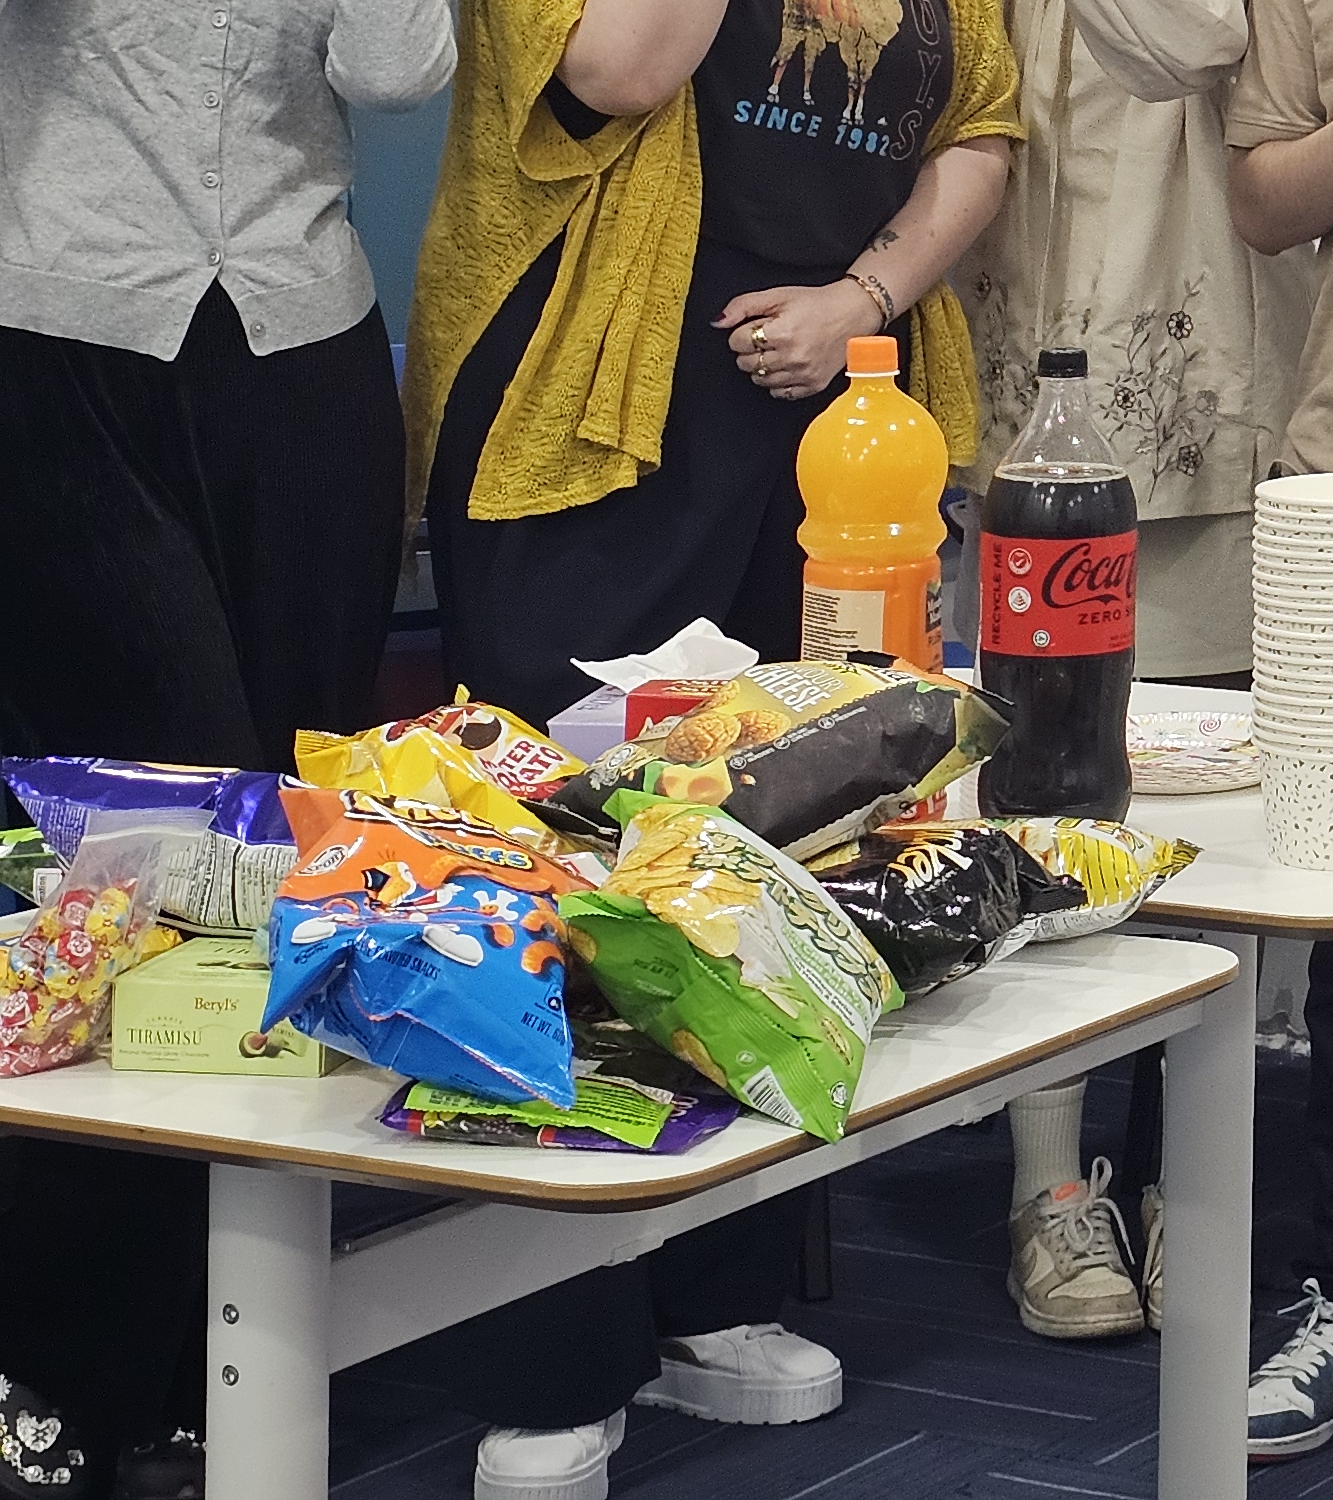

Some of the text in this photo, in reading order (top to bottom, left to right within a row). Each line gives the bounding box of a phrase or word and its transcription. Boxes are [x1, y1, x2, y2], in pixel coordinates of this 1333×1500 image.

[734, 100, 890, 157] SINCE 1982
[1078, 610, 1122, 626] ZERO
[744, 664, 832, 713] CHEESE
[194, 997, 238, 1014] Beryl's
[520, 1010, 538, 1029] NET
[538, 1016, 552, 1036] WT.
[127, 1028, 202, 1046] TIRAMISU
